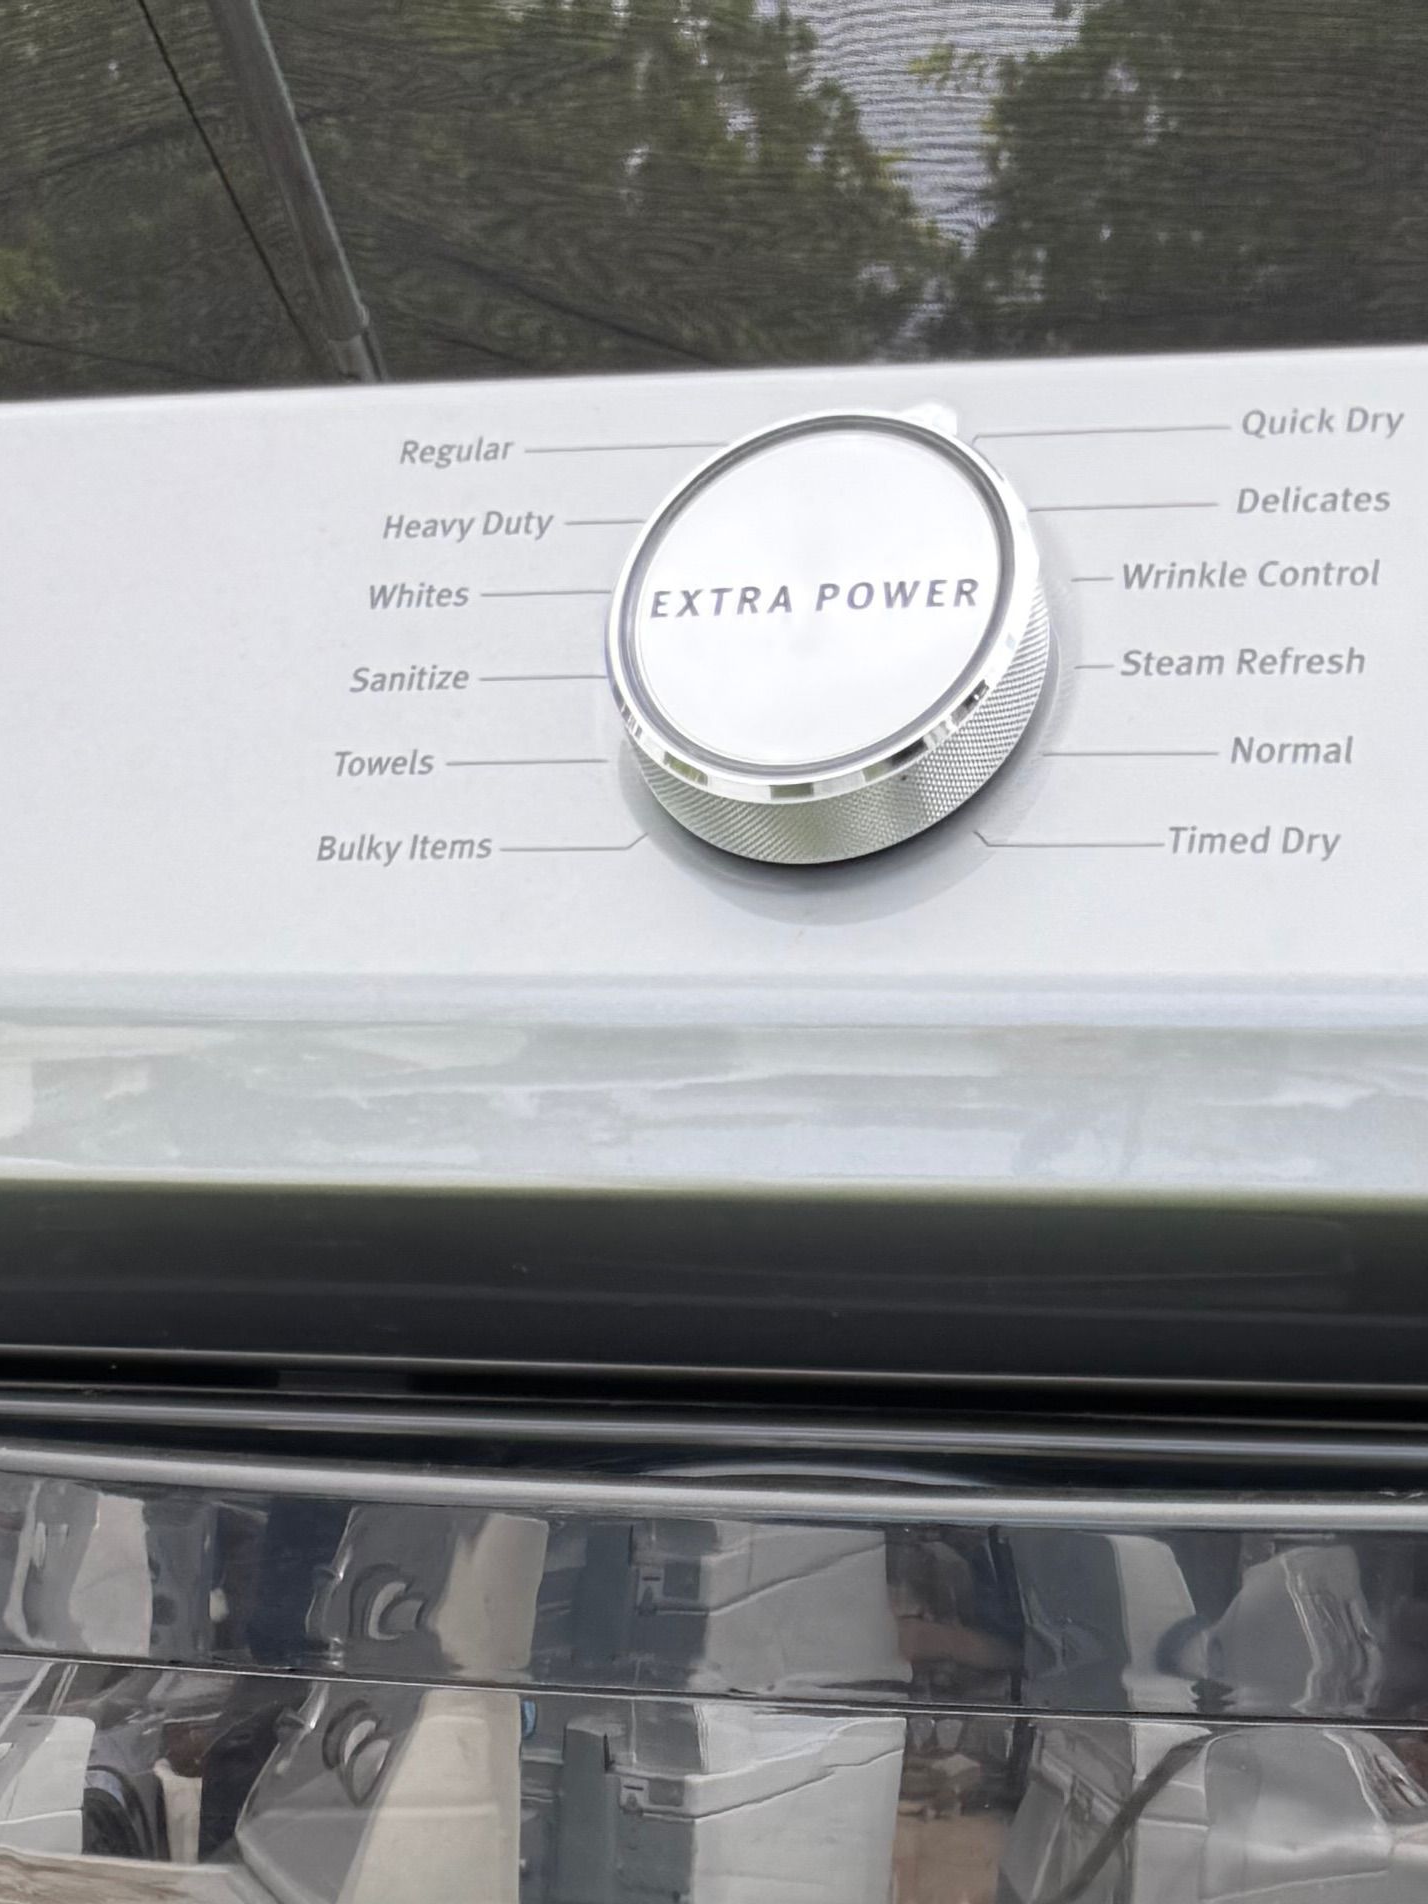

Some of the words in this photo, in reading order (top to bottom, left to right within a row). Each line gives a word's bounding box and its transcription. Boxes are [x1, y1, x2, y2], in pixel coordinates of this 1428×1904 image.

[1241, 407, 1336, 439] Quick
[1345, 406, 1405, 438] Dry
[399, 437, 514, 469] Regular
[1236, 486, 1391, 514] Delicates
[382, 513, 474, 542] Heavy
[482, 510, 554, 540] Duty
[1122, 561, 1248, 590] Wrinkle
[1257, 559, 1381, 588] Control
[368, 582, 470, 610] Whites
[649, 585, 793, 618] EXTRA
[815, 577, 980, 612] POWER
[1120, 649, 1225, 677] Steam
[1236, 647, 1366, 675] Refresh
[348, 665, 470, 693] Sanitize
[334, 749, 434, 777] Towels
[1230, 735, 1354, 764] Normal
[316, 834, 401, 867] Bulky
[408, 836, 493, 861] Items
[1169, 826, 1270, 854] Timed
[1282, 826, 1341, 861] Dry
